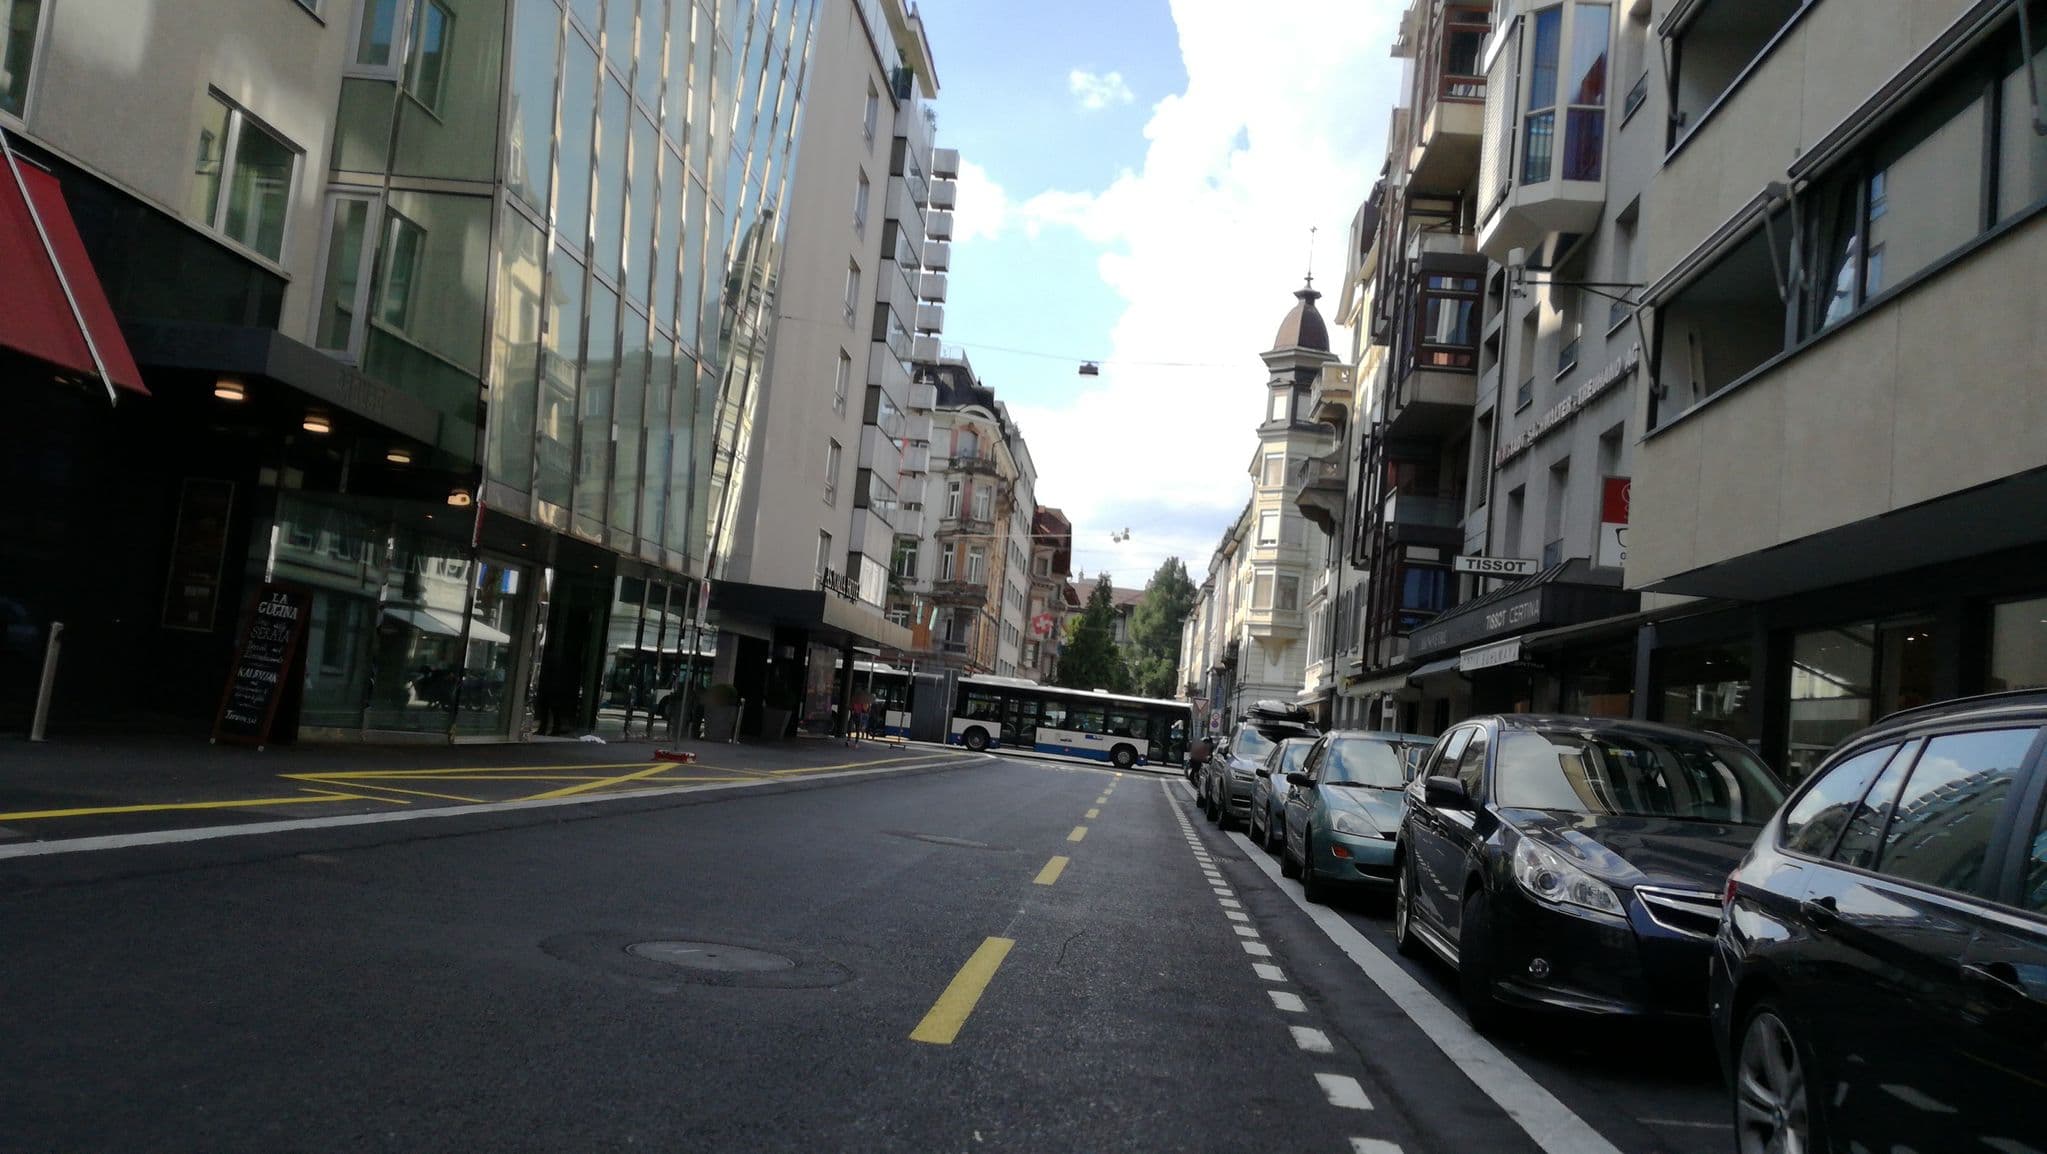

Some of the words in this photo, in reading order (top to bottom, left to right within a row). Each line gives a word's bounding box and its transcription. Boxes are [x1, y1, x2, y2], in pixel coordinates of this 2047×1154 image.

[1465, 558, 1526, 572] TISSOT
[258, 601, 298, 620] CUCINA
[1485, 610, 1508, 630] TISSOT
[1508, 599, 1540, 624] CERTINA
